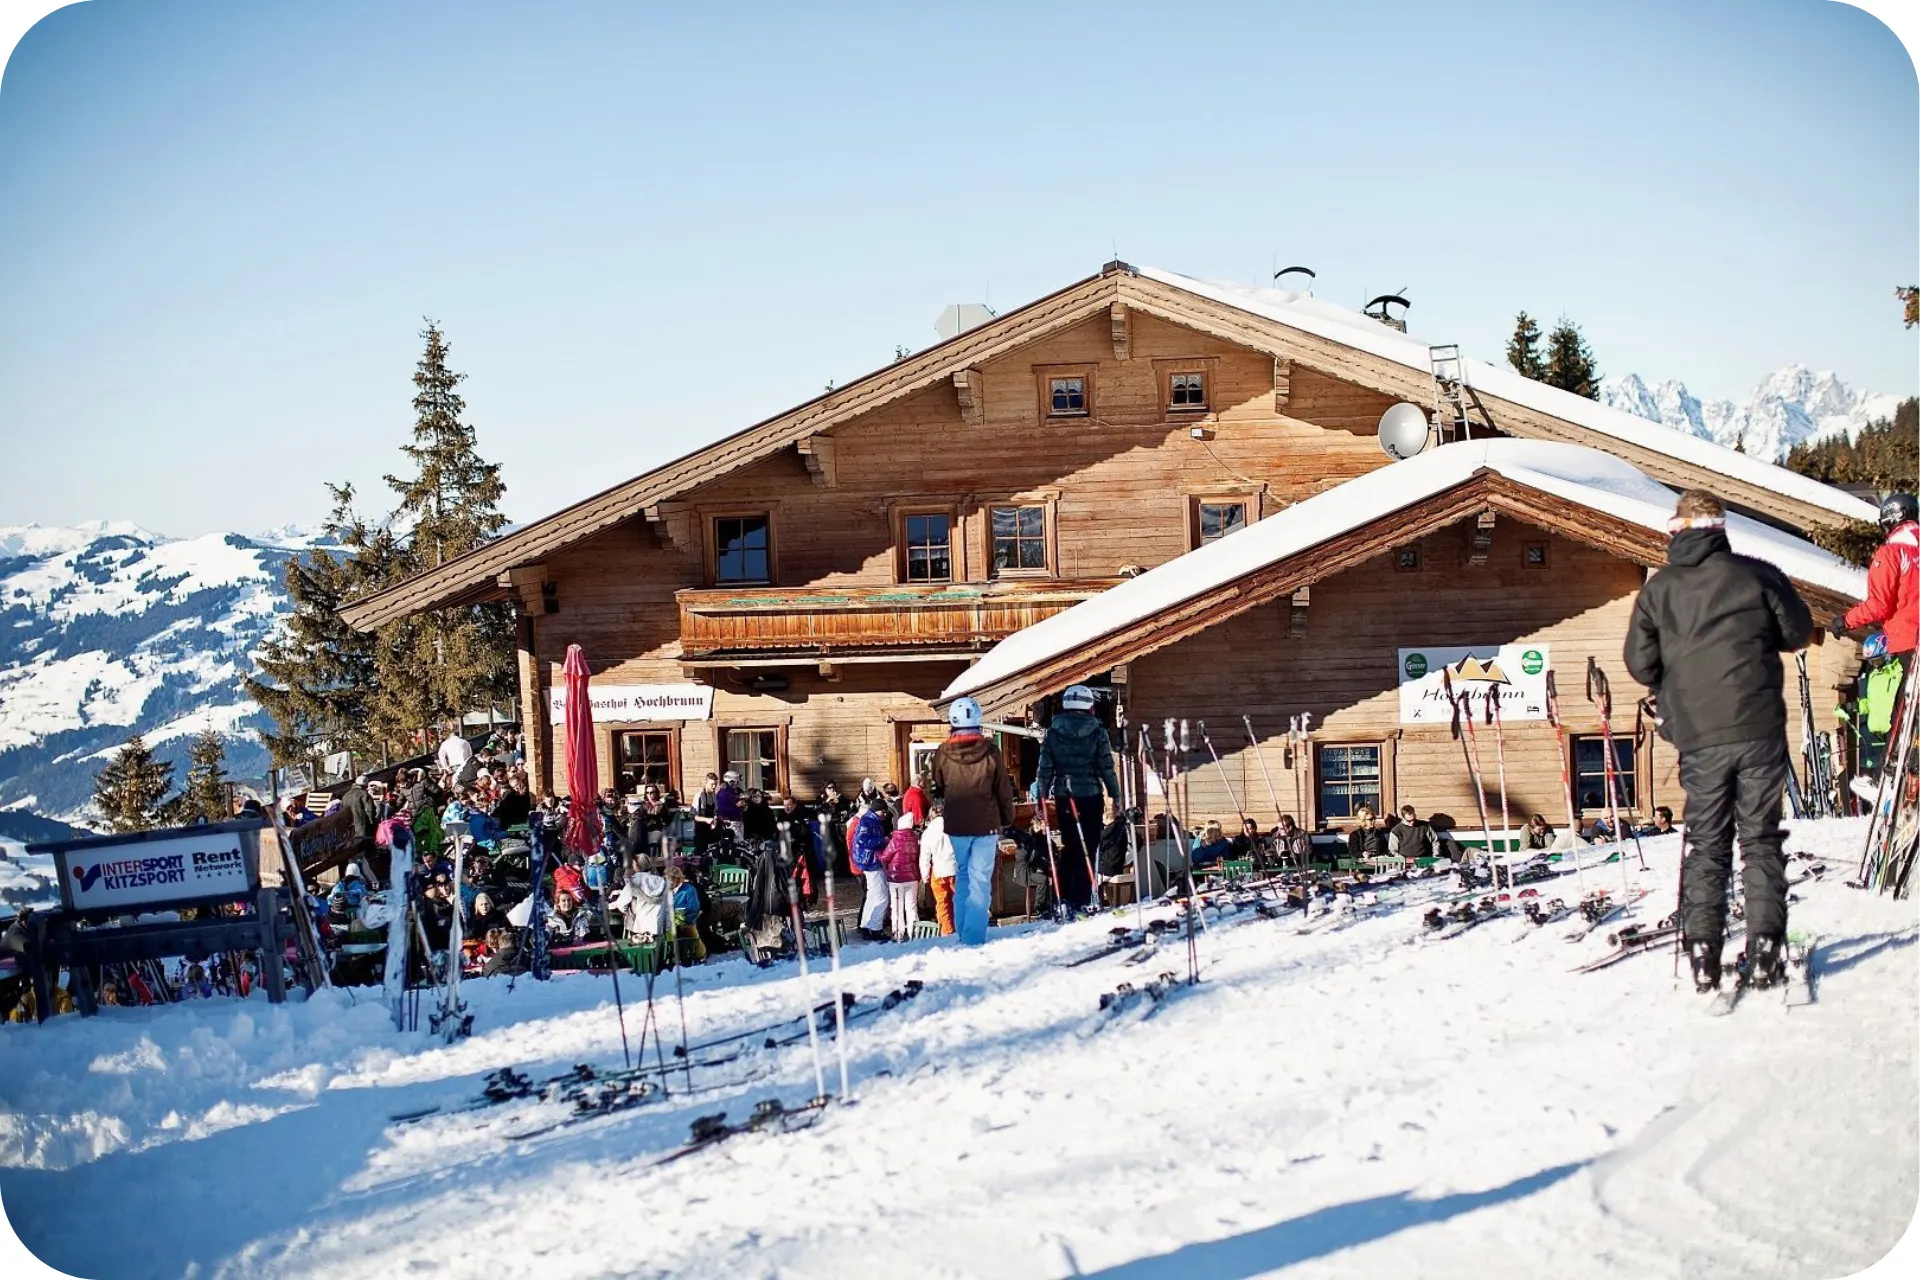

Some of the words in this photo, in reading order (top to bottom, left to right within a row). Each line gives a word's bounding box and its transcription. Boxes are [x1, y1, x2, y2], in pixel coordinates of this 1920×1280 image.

[633, 694, 704, 709] Hochbrunn
[192, 847, 241, 865] Rent
[102, 854, 184, 877] INTERSPORT
[194, 860, 242, 872] Network
[104, 867, 186, 891] KITZSPORT
